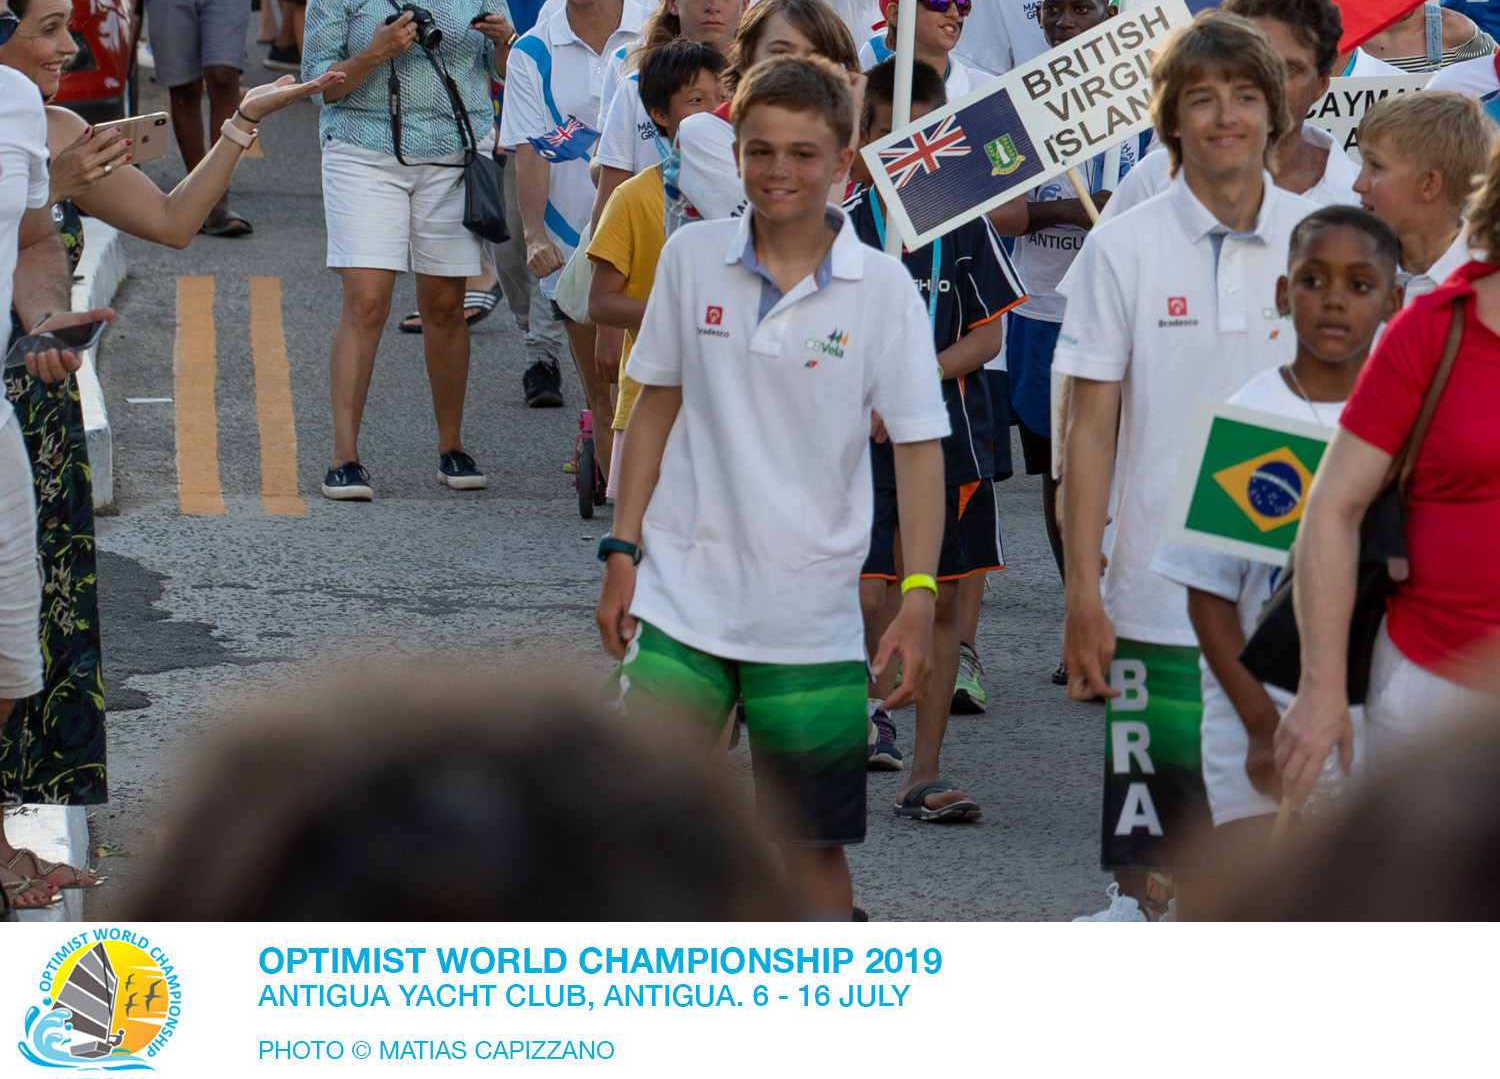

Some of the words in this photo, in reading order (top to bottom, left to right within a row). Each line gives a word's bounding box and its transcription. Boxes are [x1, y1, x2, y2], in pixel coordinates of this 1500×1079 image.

[1021, 5, 1171, 101] BRITISH
[1044, 89, 1153, 164] ISLAN
[1305, 87, 1423, 119] AYM
[1029, 232, 1084, 250] ANTIGU
[1158, 318, 1198, 328] Bradesco
[1110, 659, 1163, 836] BRA
